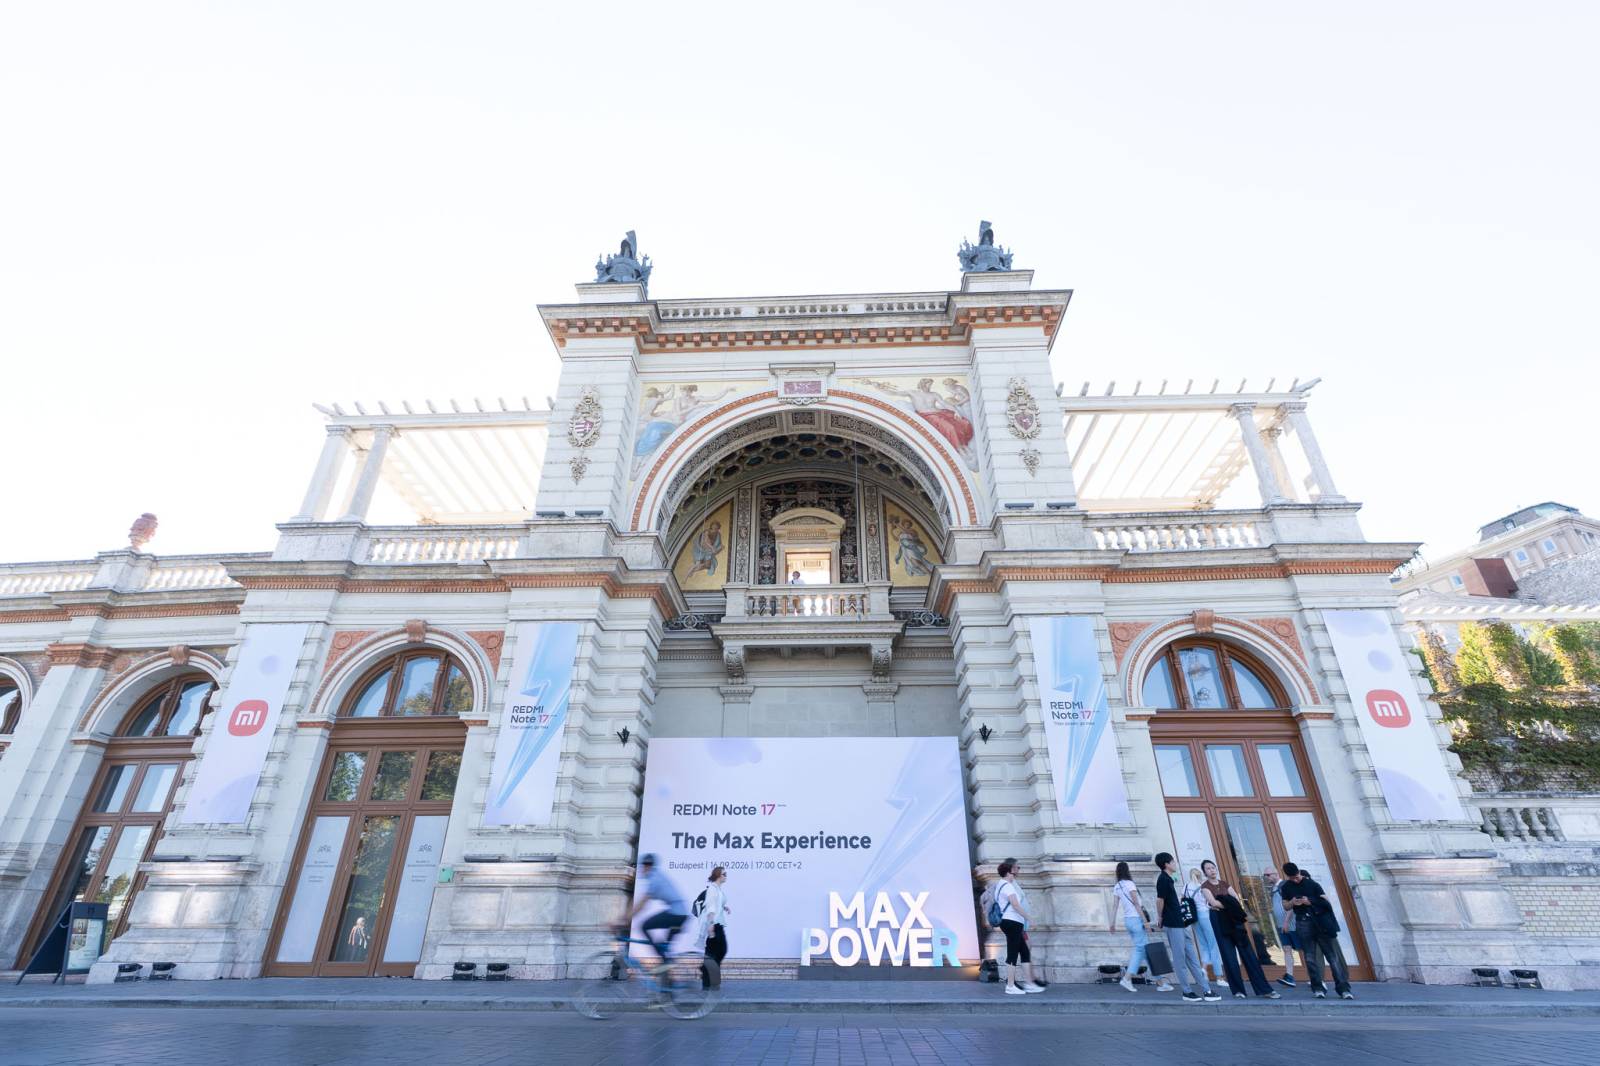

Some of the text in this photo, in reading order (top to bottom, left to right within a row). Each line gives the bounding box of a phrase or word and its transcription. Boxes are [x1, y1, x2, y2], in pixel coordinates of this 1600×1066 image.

[512, 705, 544, 714] REDMI
[1050, 701, 1084, 710] REDMI
[510, 714, 549, 723] Note 17
[1051, 710, 1092, 720] Note 17
[673, 804, 776, 816] REDMI Note 17
[672, 831, 872, 853] The Max Experience
[669, 861, 704, 871] Budapest
[710, 861, 749, 870] 1609.2026
[756, 861, 775, 870] 17:00
[777, 861, 802, 870] CET+2
[829, 891, 933, 929] MAX
[800, 927, 962, 967] POWER
